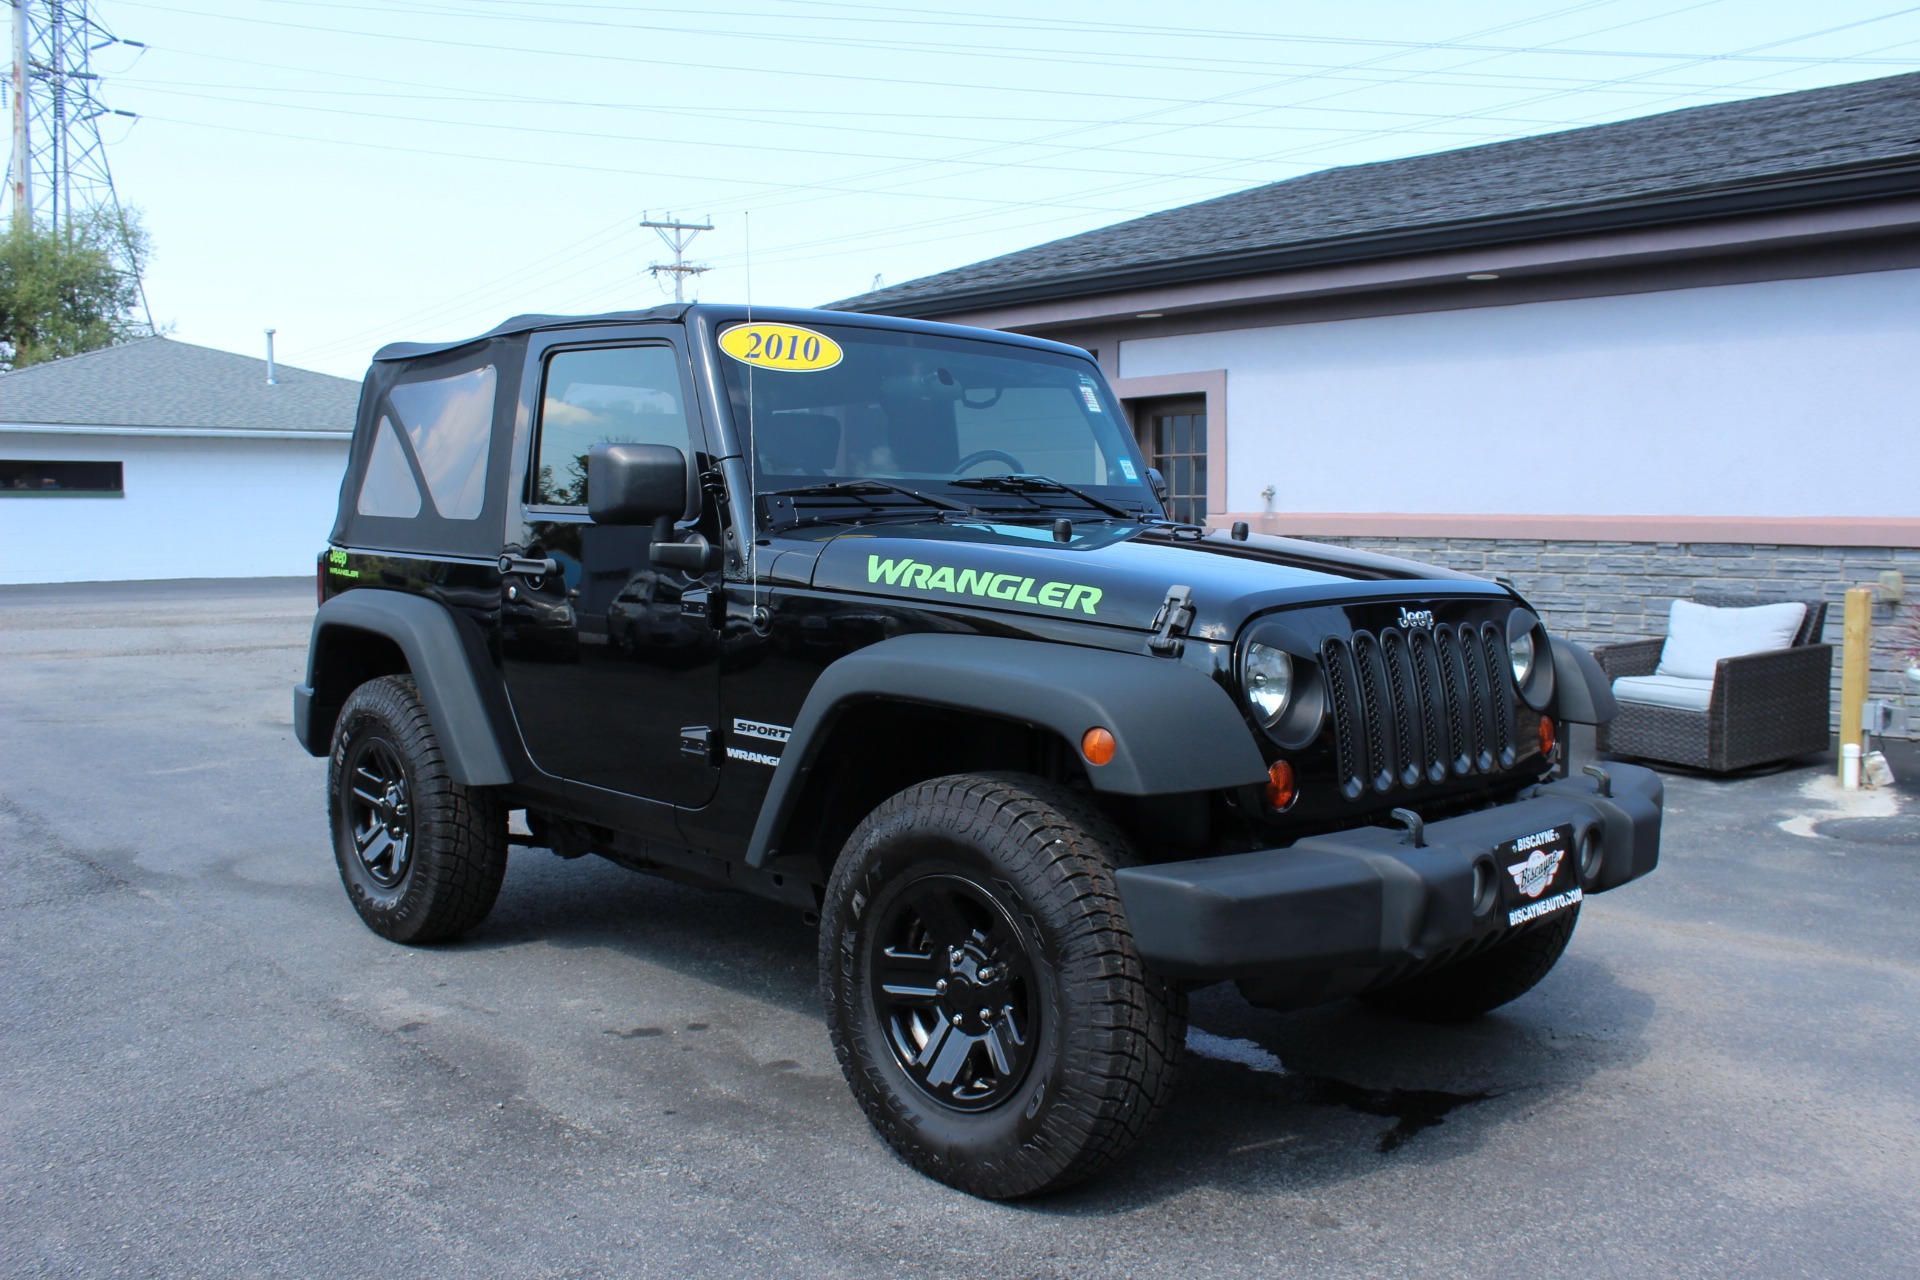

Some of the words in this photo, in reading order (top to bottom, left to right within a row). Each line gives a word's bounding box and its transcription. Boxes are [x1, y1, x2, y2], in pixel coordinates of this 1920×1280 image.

[744, 332, 821, 362] 2010
[329, 567, 359, 578] WRANGLER
[867, 554, 1103, 615] WRANGLER
[1397, 606, 1434, 630] Jeep
[735, 722, 791, 739] SPORT
[1517, 829, 1556, 852] BISCAYNE
[1508, 887, 1584, 927] BISCAYNEAUTO.COM
